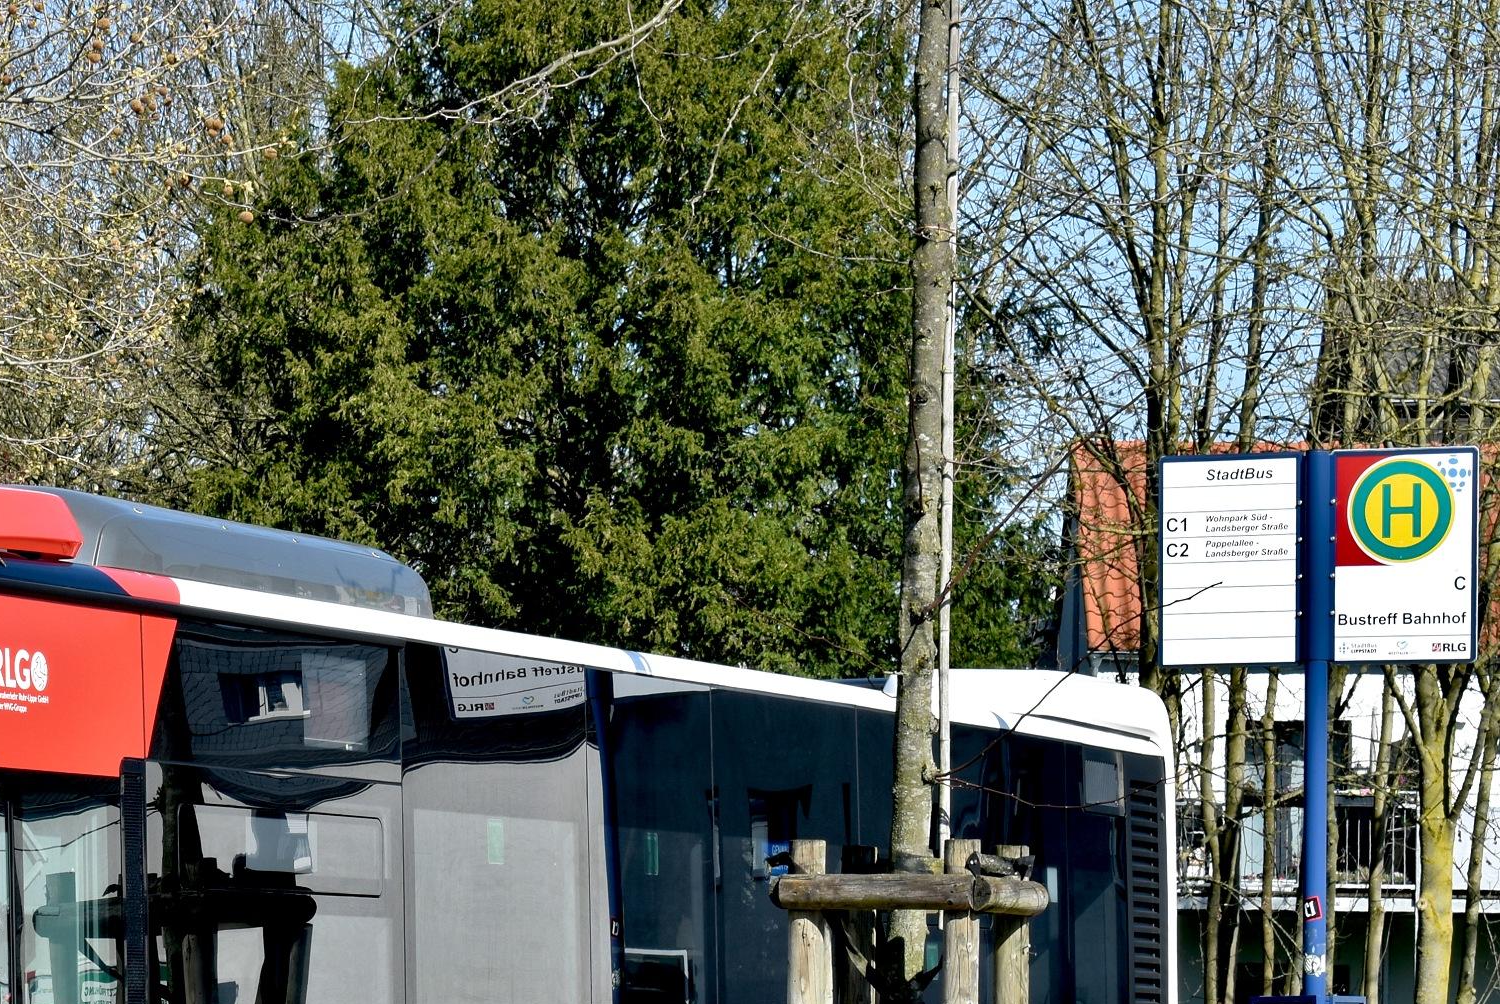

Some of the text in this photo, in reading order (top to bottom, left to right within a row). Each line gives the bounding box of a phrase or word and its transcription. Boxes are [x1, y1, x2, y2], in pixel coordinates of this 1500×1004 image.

[1206, 467, 1274, 481] StadtBus
[1381, 483, 1422, 538] H
[1166, 517, 1188, 532] C1
[1205, 514, 1248, 523] Wohnpark
[1251, 513, 1268, 521] Süd
[1205, 523, 1289, 533] Landsberger Straße
[1166, 543, 1189, 558] C2
[1205, 540, 1254, 549] Pappelallee
[1205, 548, 1289, 558] Landsberger Straße
[1454, 576, 1466, 590] C
[1338, 611, 1467, 626] Bustreff Bahnhof
[1442, 642, 1467, 652] RLG
